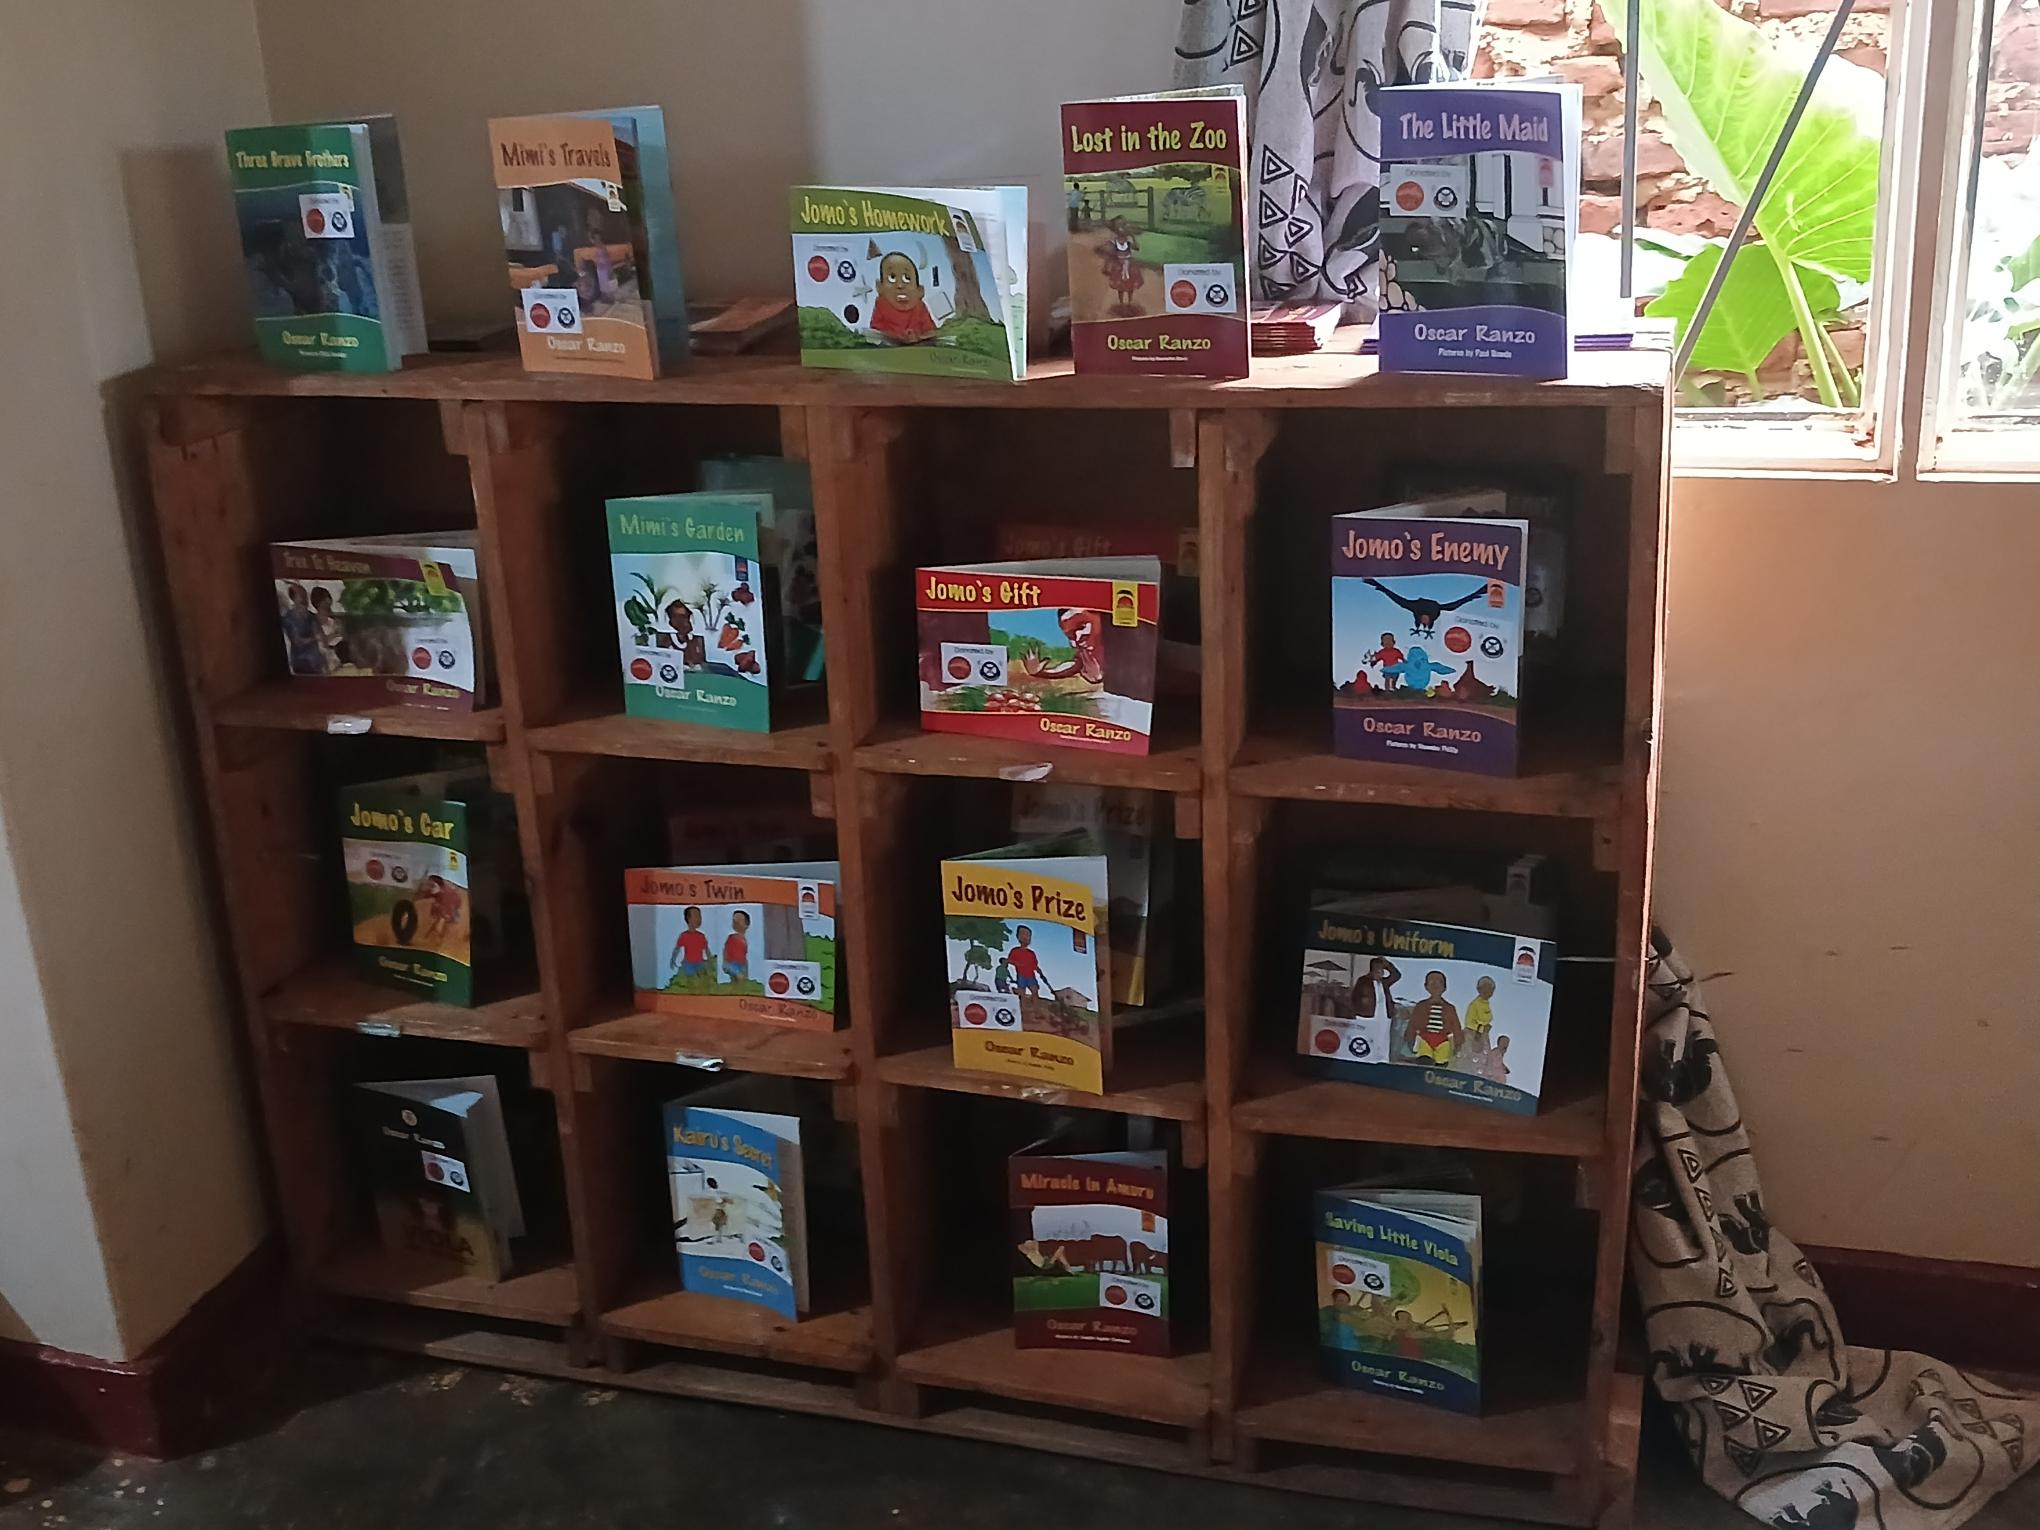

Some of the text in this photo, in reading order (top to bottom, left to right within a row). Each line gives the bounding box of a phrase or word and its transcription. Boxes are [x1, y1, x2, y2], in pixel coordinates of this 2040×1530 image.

[1071, 121, 1228, 152] Lost in the Zoo
[1400, 112, 1548, 142] The Little Maid
[236, 151, 268, 168] Three
[305, 149, 350, 168] Brothers
[501, 141, 611, 168] Mimi's Travels
[800, 196, 950, 237] Jomo's Homework
[1107, 334, 1211, 350] Oscar Ranzo
[1414, 323, 1536, 344] Oscar Ranzo
[620, 513, 745, 543] Mimi's Garden
[1341, 529, 1509, 571] Jomo's Enemy
[926, 576, 1041, 606] Jomo's Gift
[1040, 718, 1081, 735] Oscar
[1085, 722, 1132, 742] Ranzo
[1363, 717, 1482, 743] Oscar Ranzo
[351, 803, 455, 840] Jomo's Car
[641, 876, 745, 900] Jomo's Twin
[952, 876, 1086, 921] Jomo's Prize
[1318, 920, 1454, 958] Jomo's Uniform
[1424, 1070, 1467, 1090] Oscar
[1473, 1081, 1522, 1102] Ranzo
[1021, 1173, 1080, 1191] Miracle
[1086, 1177, 1100, 1192] in
[1325, 1211, 1459, 1267] Saving Little Viola
